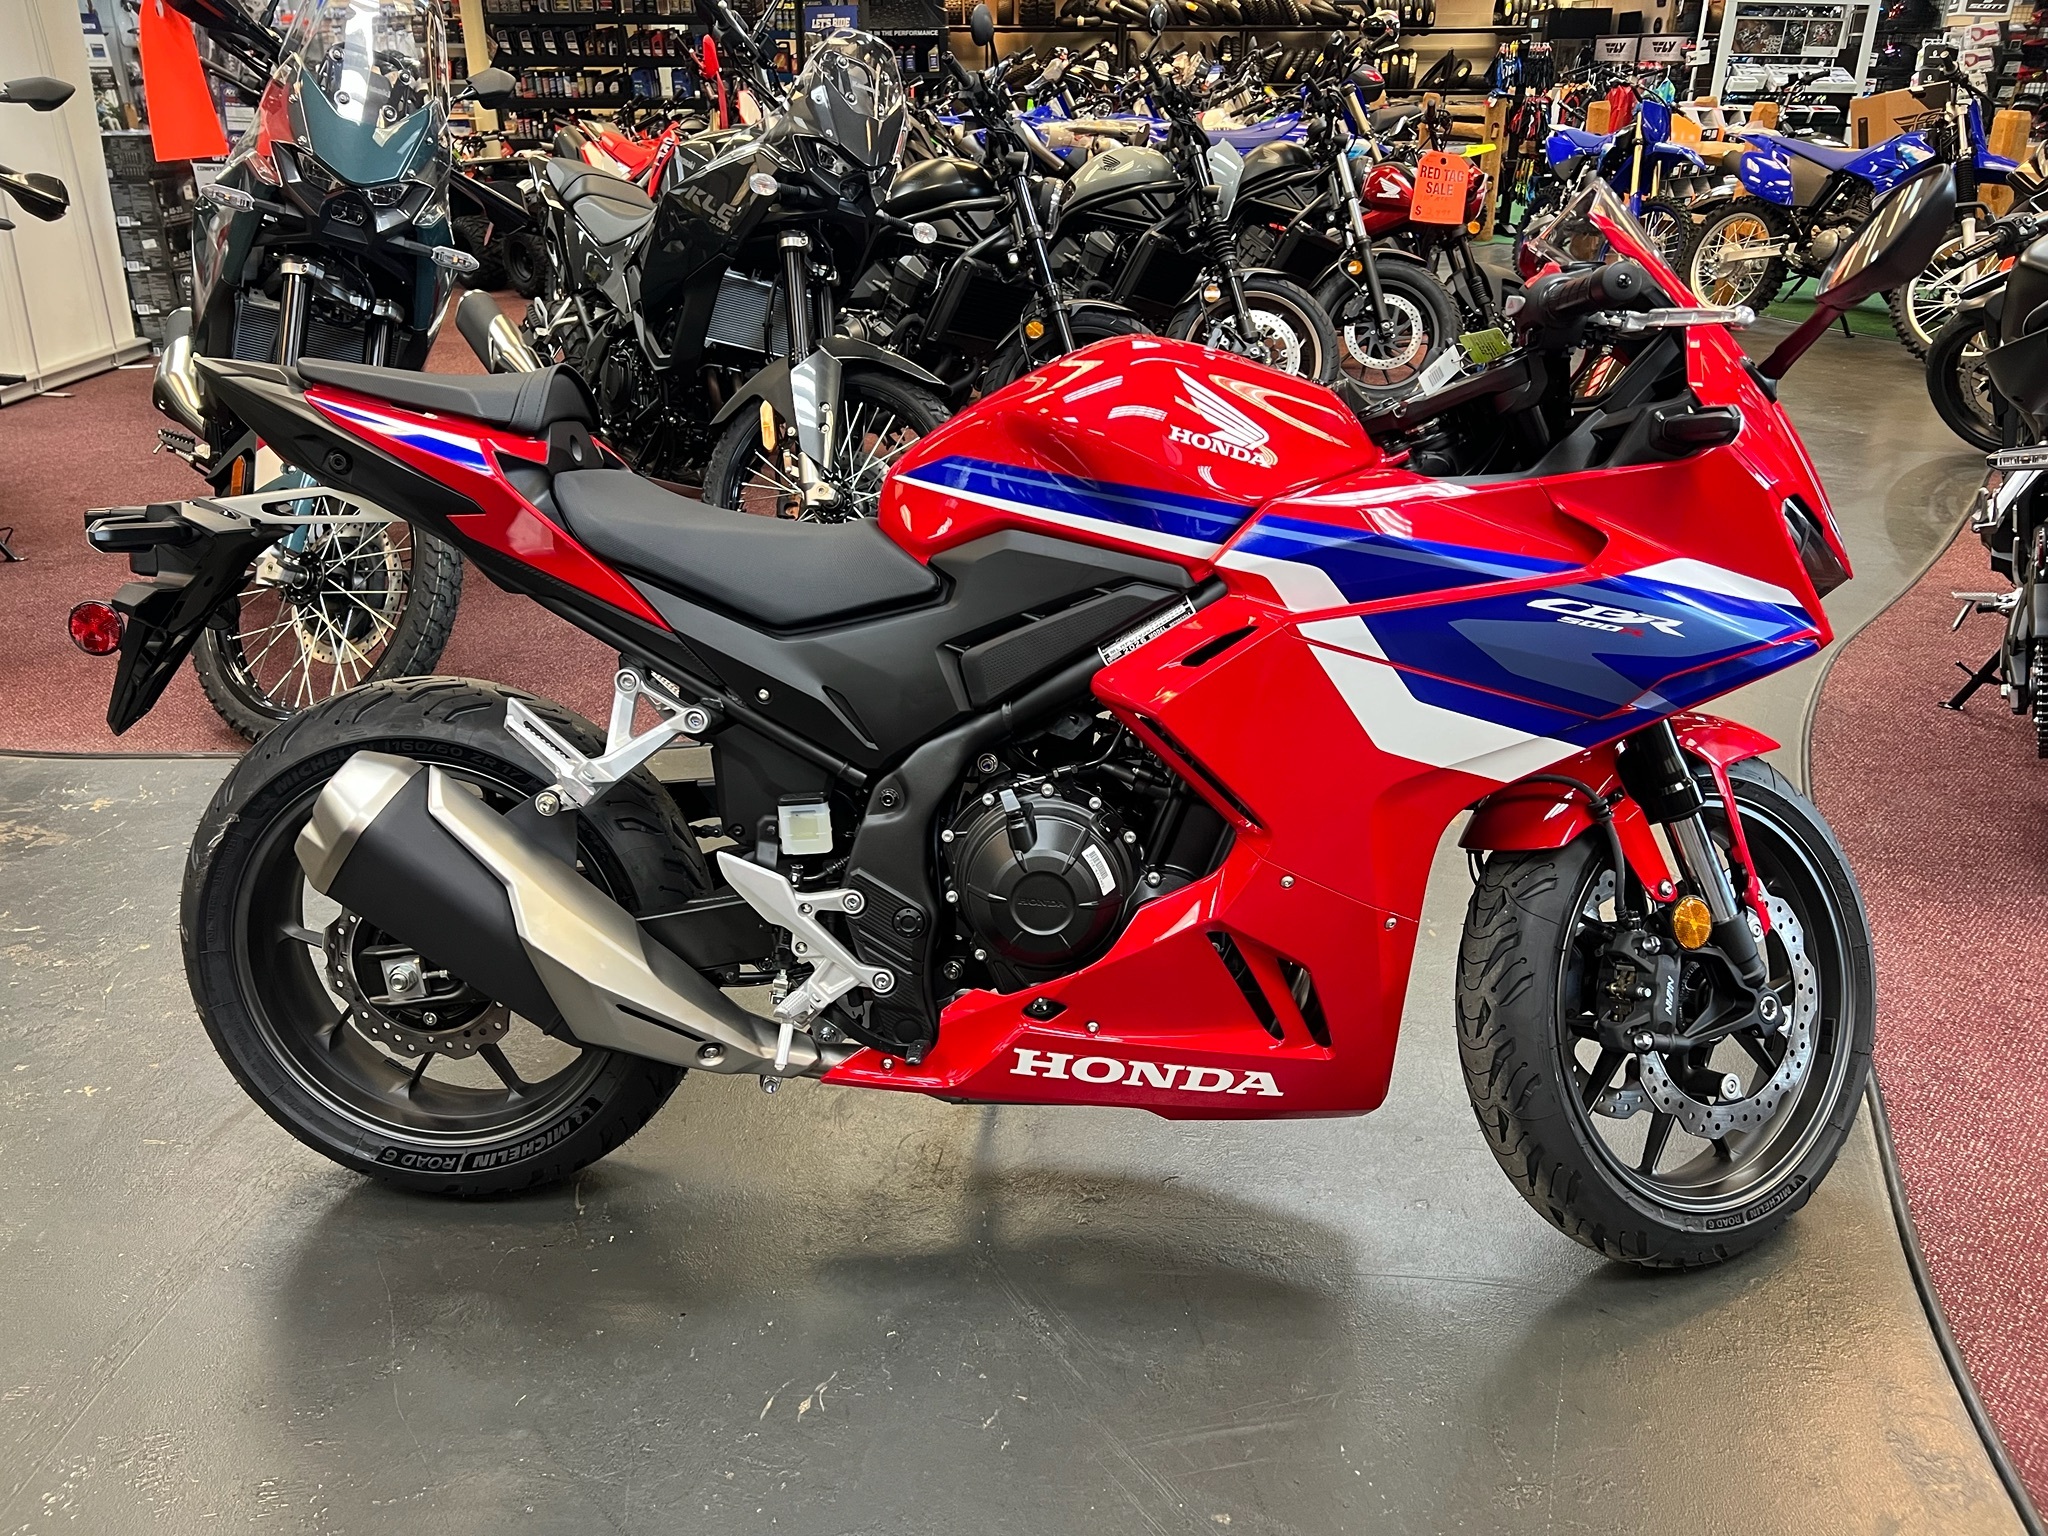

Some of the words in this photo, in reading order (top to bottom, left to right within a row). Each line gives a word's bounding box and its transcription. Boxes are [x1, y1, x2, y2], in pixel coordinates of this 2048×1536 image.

[832, 17, 851, 28] RIDE
[893, 29, 939, 37] PERFORMANCE
[1420, 165, 1441, 180] RED
[1444, 169, 1465, 183] TAG
[1425, 181, 1454, 196] SALE
[684, 185, 736, 221] KLE
[1168, 424, 1272, 469] HONDA
[1526, 598, 1686, 638] CBR
[1557, 616, 1644, 637] 500R
[1009, 1047, 1285, 1097] HONDA
[472, 1120, 570, 1169] MICHELIN
[382, 1149, 397, 1162] 6
[401, 1152, 457, 1170] ROAD
[1749, 1184, 1792, 1219] MICHELIN
[1717, 1214, 1742, 1228] ROAD
